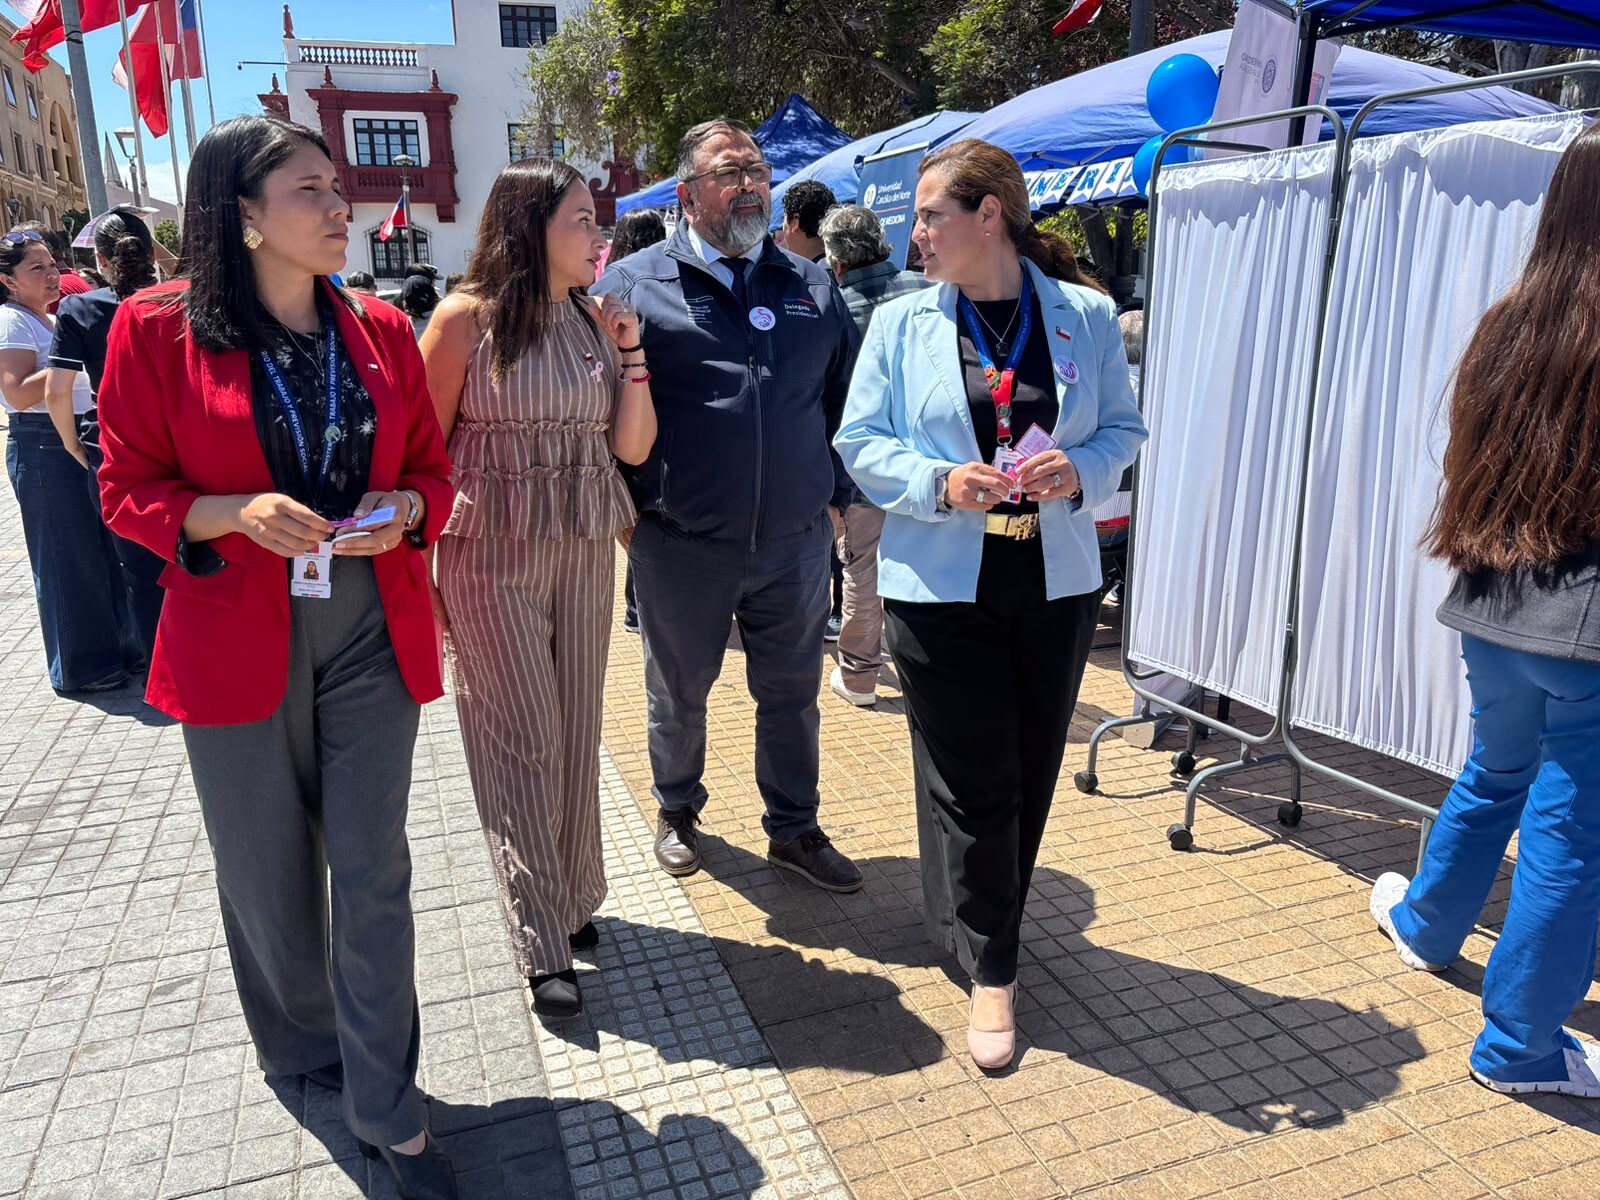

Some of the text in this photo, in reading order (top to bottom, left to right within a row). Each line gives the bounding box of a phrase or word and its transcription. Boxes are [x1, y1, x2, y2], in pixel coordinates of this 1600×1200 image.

[878, 180, 903, 194] Universidad
[784, 303, 811, 312] Delegado
[786, 310, 819, 319] Presidencial
[329, 353, 337, 385] PREVISIÓN
[329, 391, 337, 420] TRABAJO
[266, 362, 276, 376] DEL
[273, 375, 291, 405] TRABAJO
[289, 409, 304, 448] PREVISIÓN
[299, 446, 309, 473] SOCIAL
